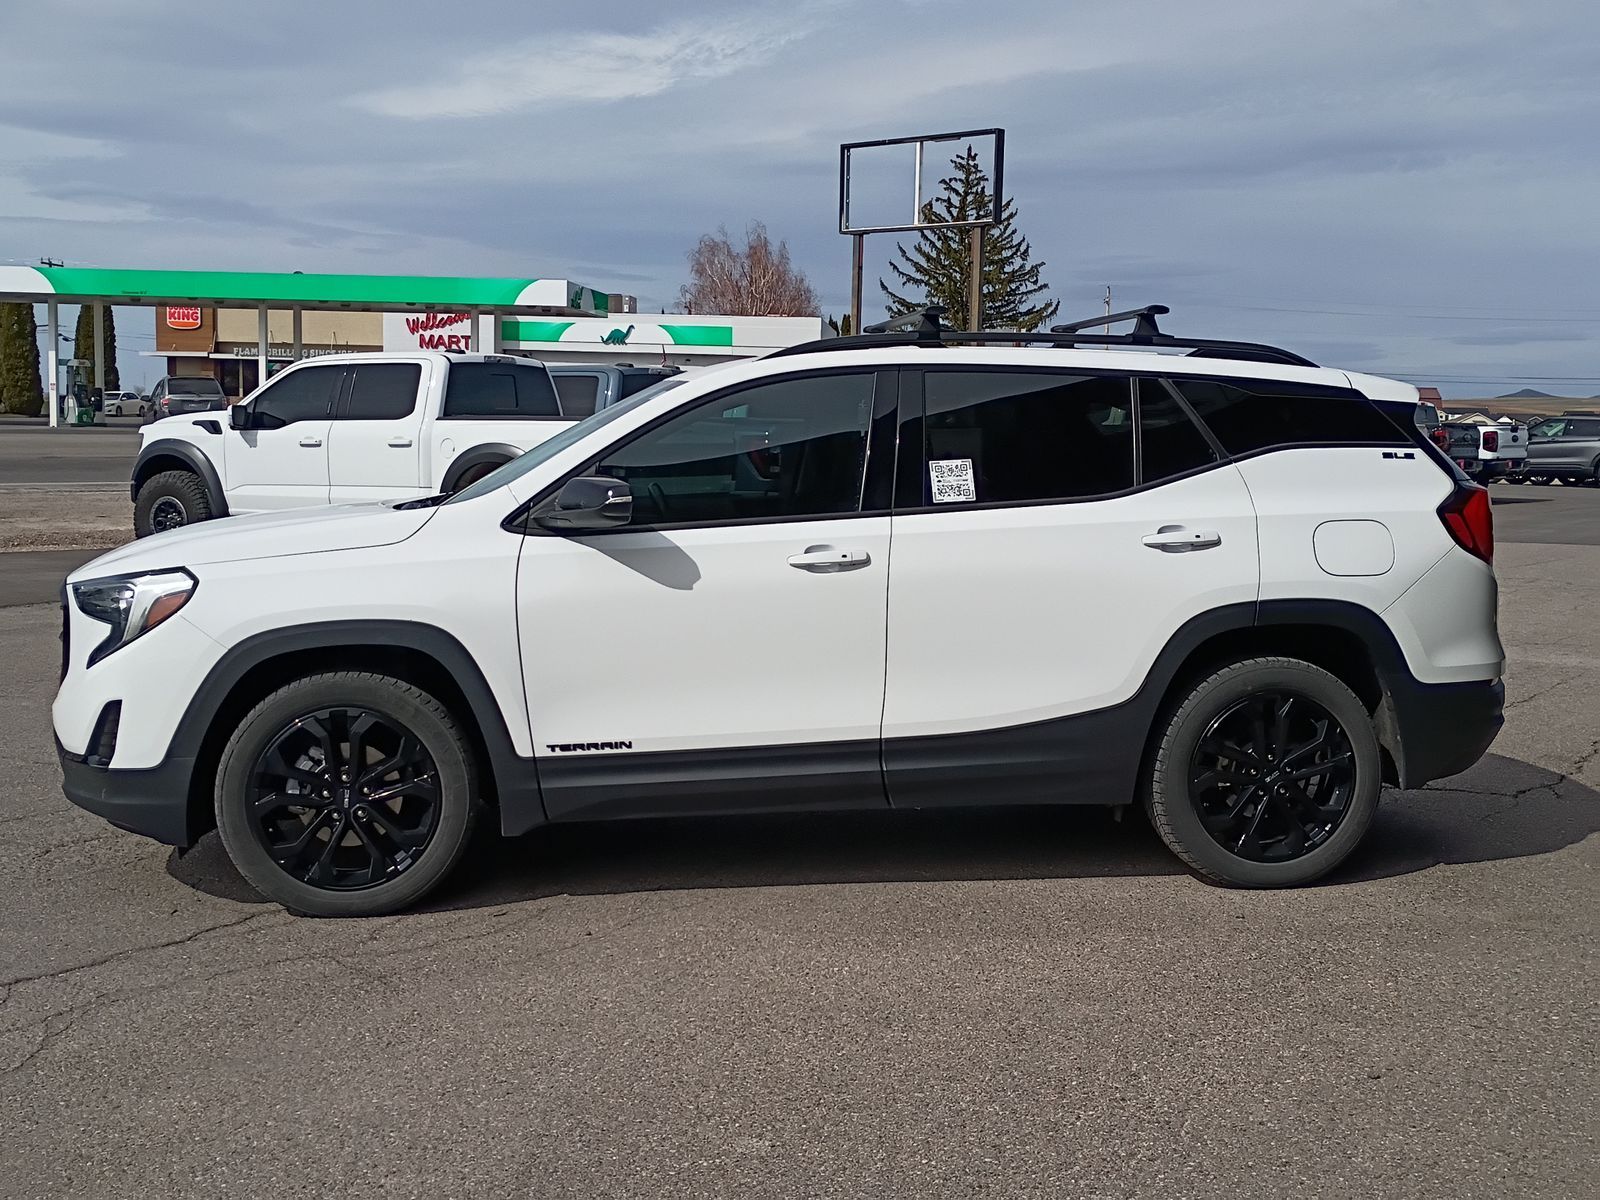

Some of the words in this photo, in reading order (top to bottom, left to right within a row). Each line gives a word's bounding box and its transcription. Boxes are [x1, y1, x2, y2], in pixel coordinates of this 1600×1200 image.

[169, 311, 199, 321] KING
[419, 334, 471, 350] MART
[233, 347, 259, 356] FLAM
[546, 741, 632, 752] TERRAIN
